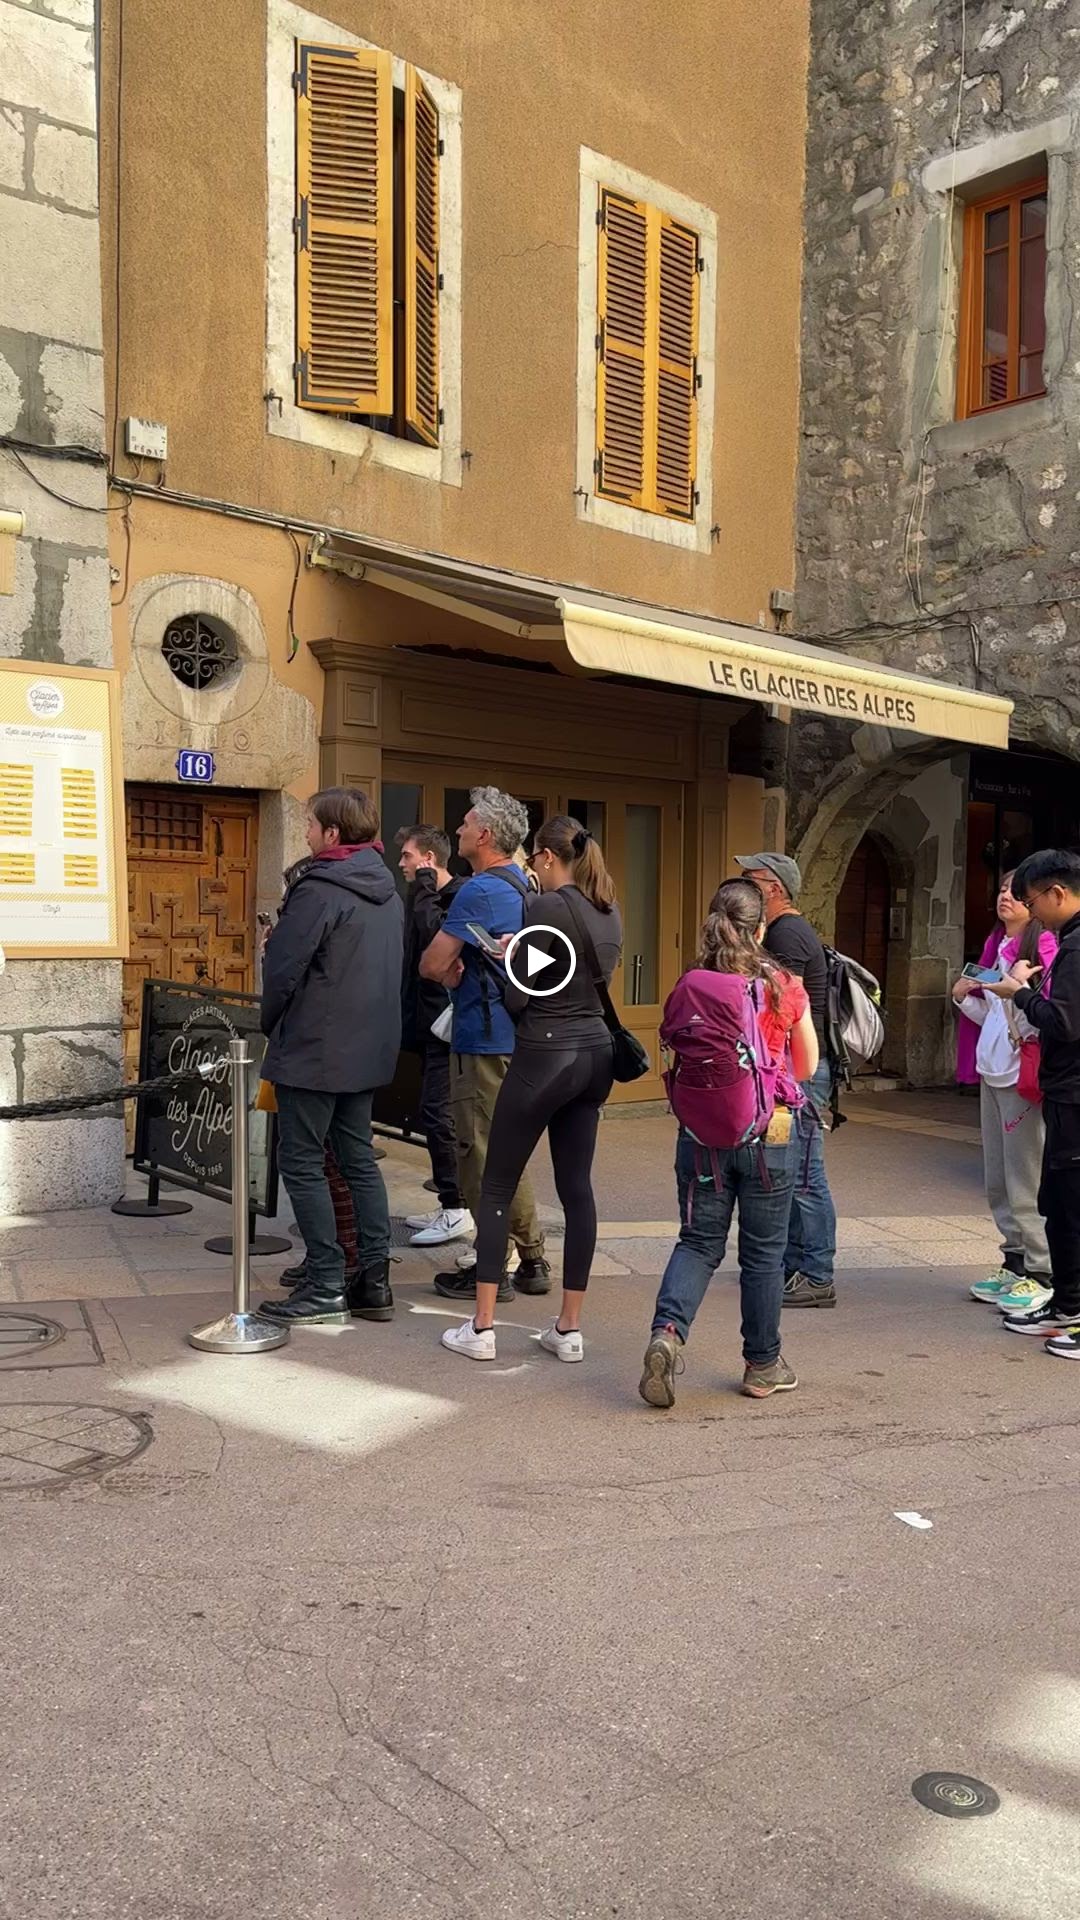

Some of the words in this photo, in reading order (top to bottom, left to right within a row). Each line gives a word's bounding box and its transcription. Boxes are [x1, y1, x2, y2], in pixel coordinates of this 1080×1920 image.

[709, 660, 736, 687] LE
[740, 667, 820, 704] GLACIER
[824, 684, 858, 711] DES
[863, 692, 915, 723] ALPES
[184, 755, 207, 778] 16
[182, 1005, 205, 1032] GLACES
[166, 1095, 188, 1124] des
[171, 1086, 233, 1152] Alpe
[183, 1151, 206, 1176] DEPUIS
